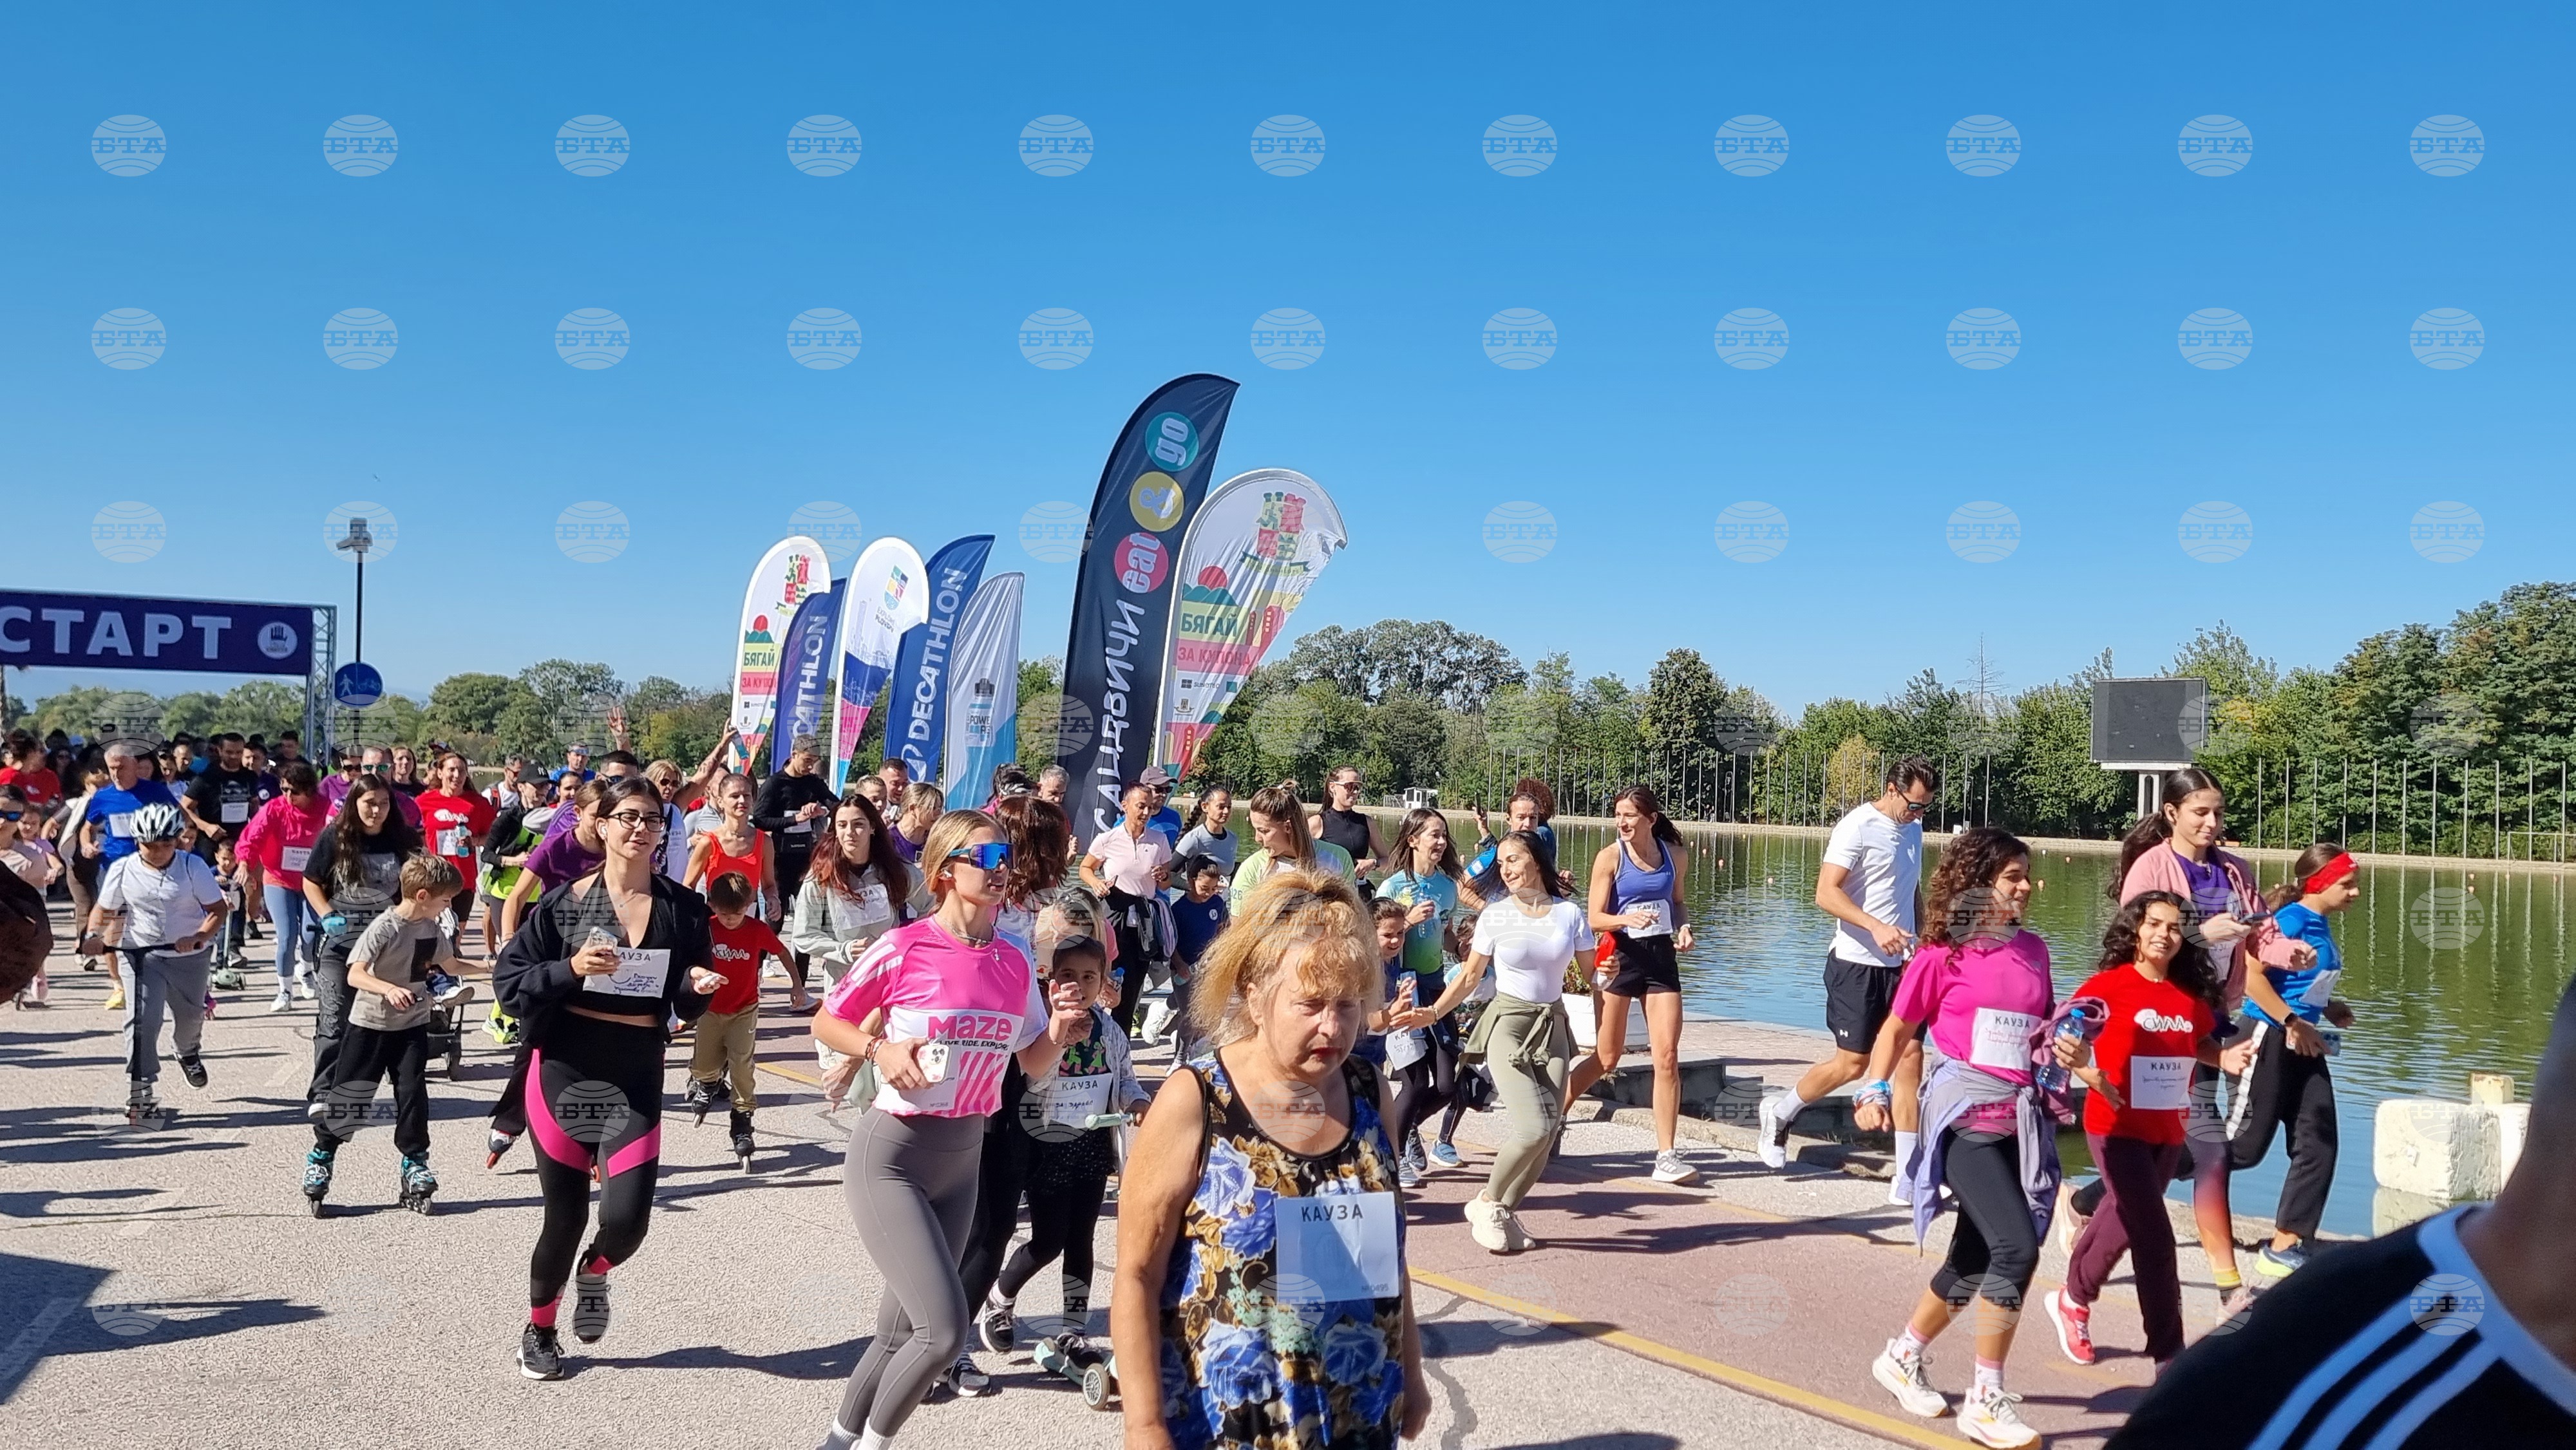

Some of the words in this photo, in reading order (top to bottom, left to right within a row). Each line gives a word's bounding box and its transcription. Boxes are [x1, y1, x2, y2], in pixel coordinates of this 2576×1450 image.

[1155, 417, 1189, 466] go
[1139, 487, 1176, 519] &
[1122, 532, 1160, 594] eat
[0, 606, 232, 659] СТАРТ
[1181, 613, 1238, 637] БЯГАЙ
[743, 648, 775, 666] БЯГАЙ
[908, 567, 968, 741] DECATHLON
[1178, 647, 1195, 662] ЗА
[1199, 648, 1251, 666] КУПОНА
[742, 677, 752, 688] ЗА
[791, 616, 828, 747] CATHLON
[1095, 599, 1145, 834] САНДВИЧИ
[620, 951, 651, 961] АУЗА
[1995, 1016, 2031, 1029] КАУЗА
[981, 1040, 1010, 1051] EXPLOR
[2151, 1062, 2182, 1071] КАУЗА
[1062, 1080, 1099, 1091] КАУЗА
[1302, 1203, 1364, 1222] КАУЗА
